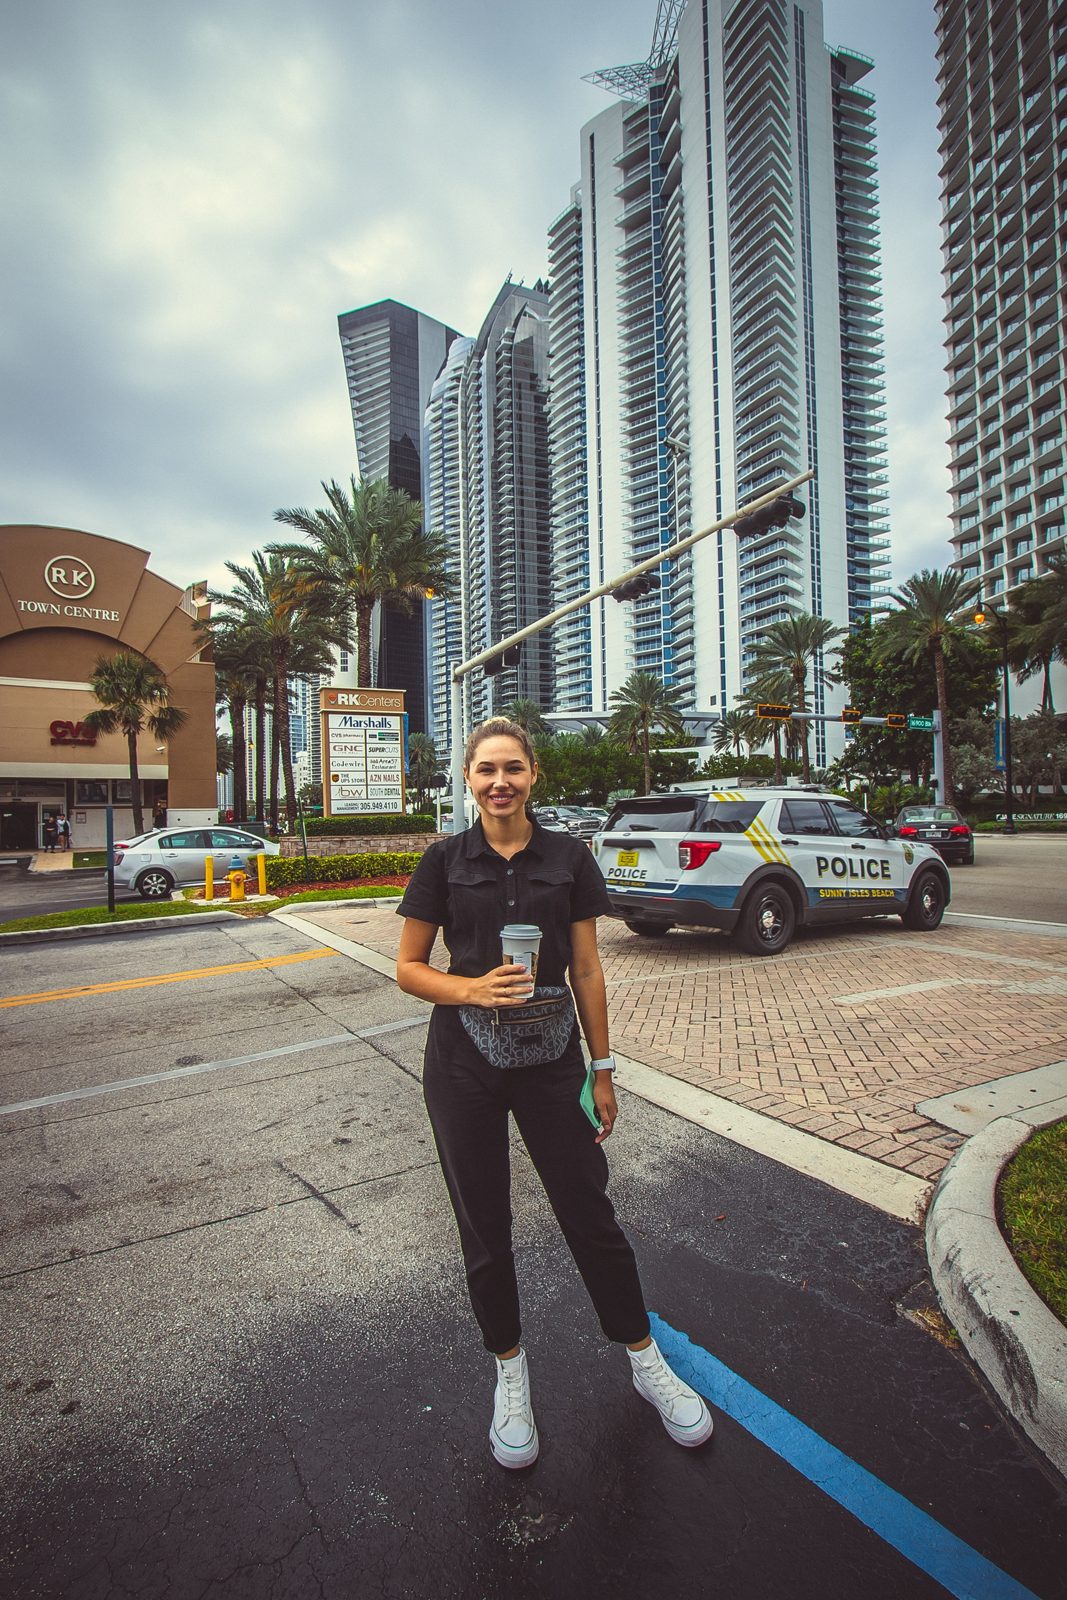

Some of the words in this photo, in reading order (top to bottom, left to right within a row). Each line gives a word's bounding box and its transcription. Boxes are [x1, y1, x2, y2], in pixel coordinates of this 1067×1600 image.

[51, 566, 89, 588] RK
[17, 600, 61, 615] TOWN
[64, 605, 120, 622] CENTRE
[339, 716, 392, 728] Marshalls
[370, 774, 382, 782] AZN
[383, 774, 400, 782] NAILS
[360, 802, 398, 810] 305.949.4110
[608, 868, 648, 879] POLICE
[815, 856, 892, 880] POLICE
[819, 889, 847, 898] SUNNY
[849, 889, 870, 898] ISLES
[872, 890, 895, 898] BEACH
